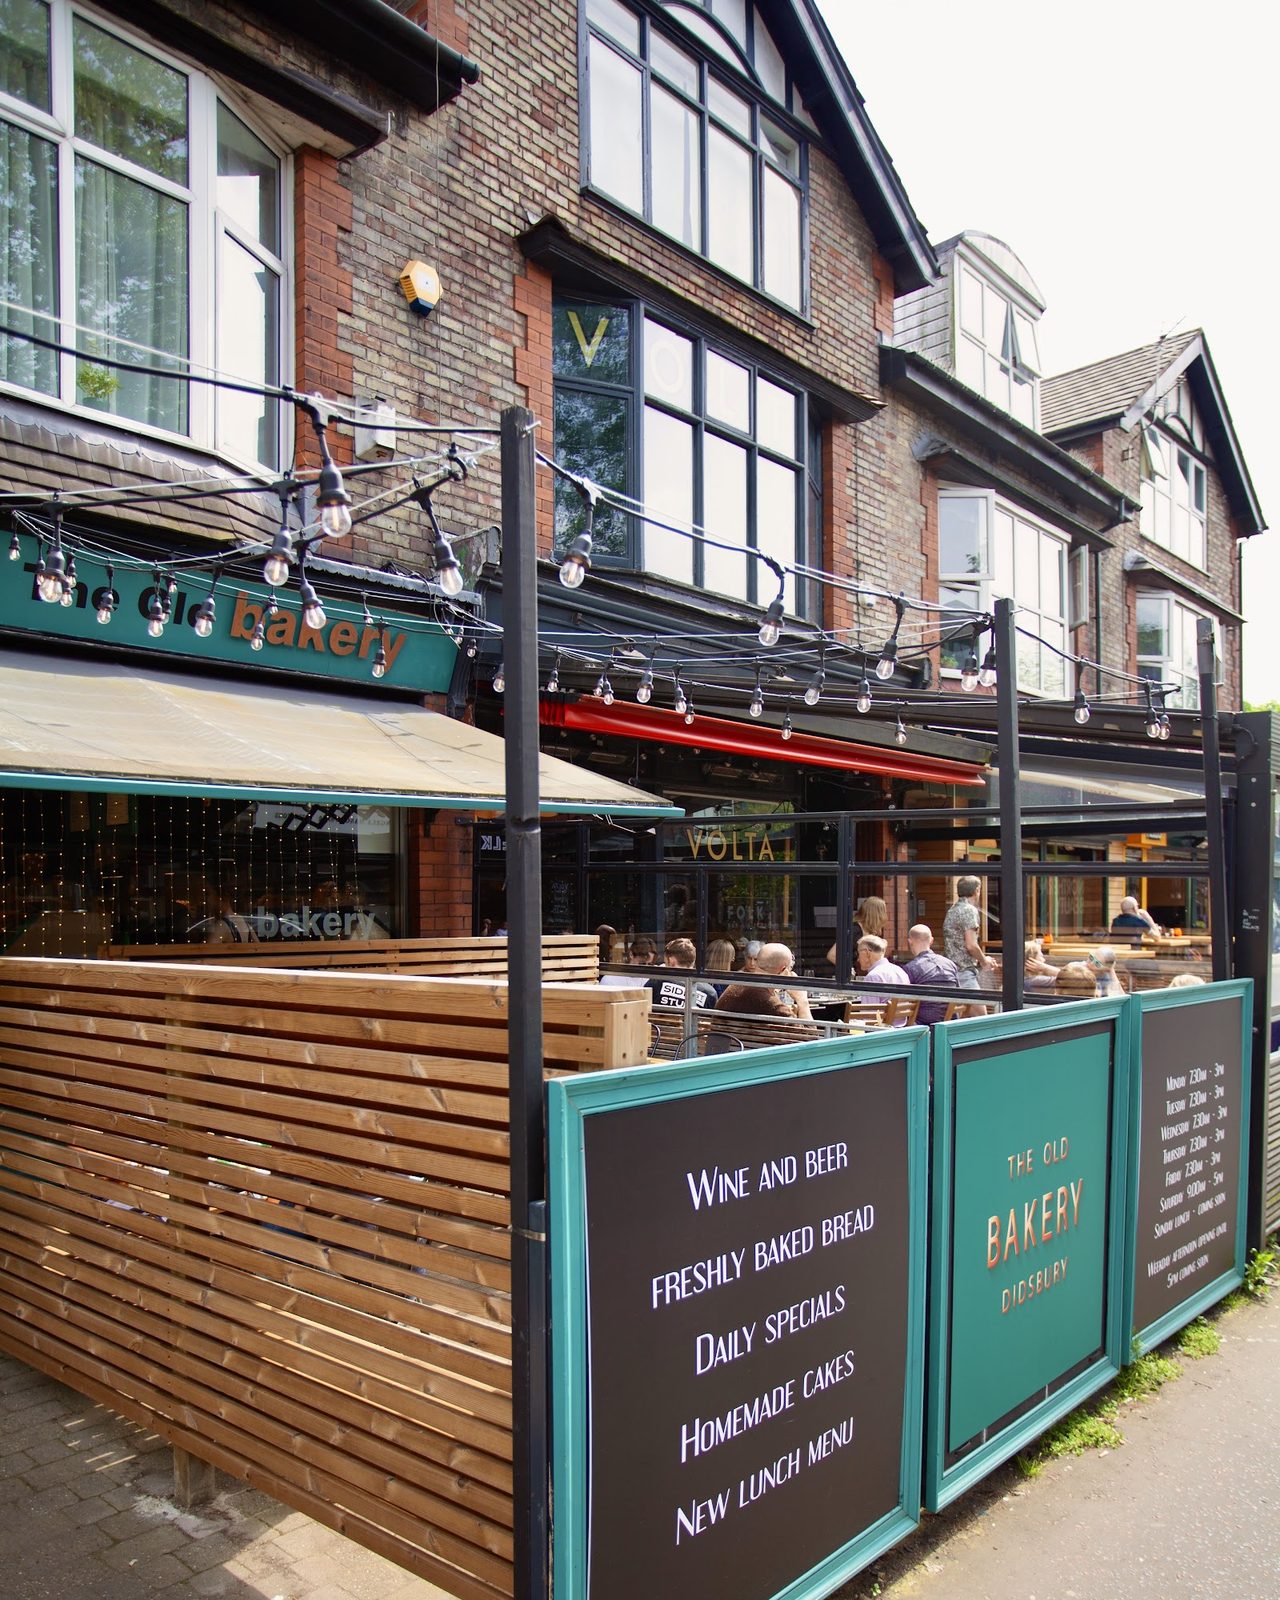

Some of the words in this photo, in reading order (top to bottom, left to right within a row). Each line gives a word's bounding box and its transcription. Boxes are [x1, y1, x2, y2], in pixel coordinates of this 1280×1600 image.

[230, 592, 406, 672] bakery
[686, 829, 775, 861] VOLTA
[256, 906, 375, 939] bakery
[758, 1155, 797, 1192] AND
[805, 1142, 849, 1178] BEER
[1008, 1149, 1034, 1179] THE
[1044, 1137, 1069, 1165] OLD
[987, 1178, 1084, 1270] BAKERY
[651, 1247, 746, 1309] FRESHLY
[754, 1225, 814, 1272] BAKED
[821, 1204, 875, 1247] BREAD
[1001, 1256, 1069, 1314] DIDSBURY
[765, 1285, 846, 1344] SPECIALS
[802, 1350, 855, 1398] CAKES
[738, 1447, 801, 1508] LUNCH
[808, 1417, 854, 1466] MENU
